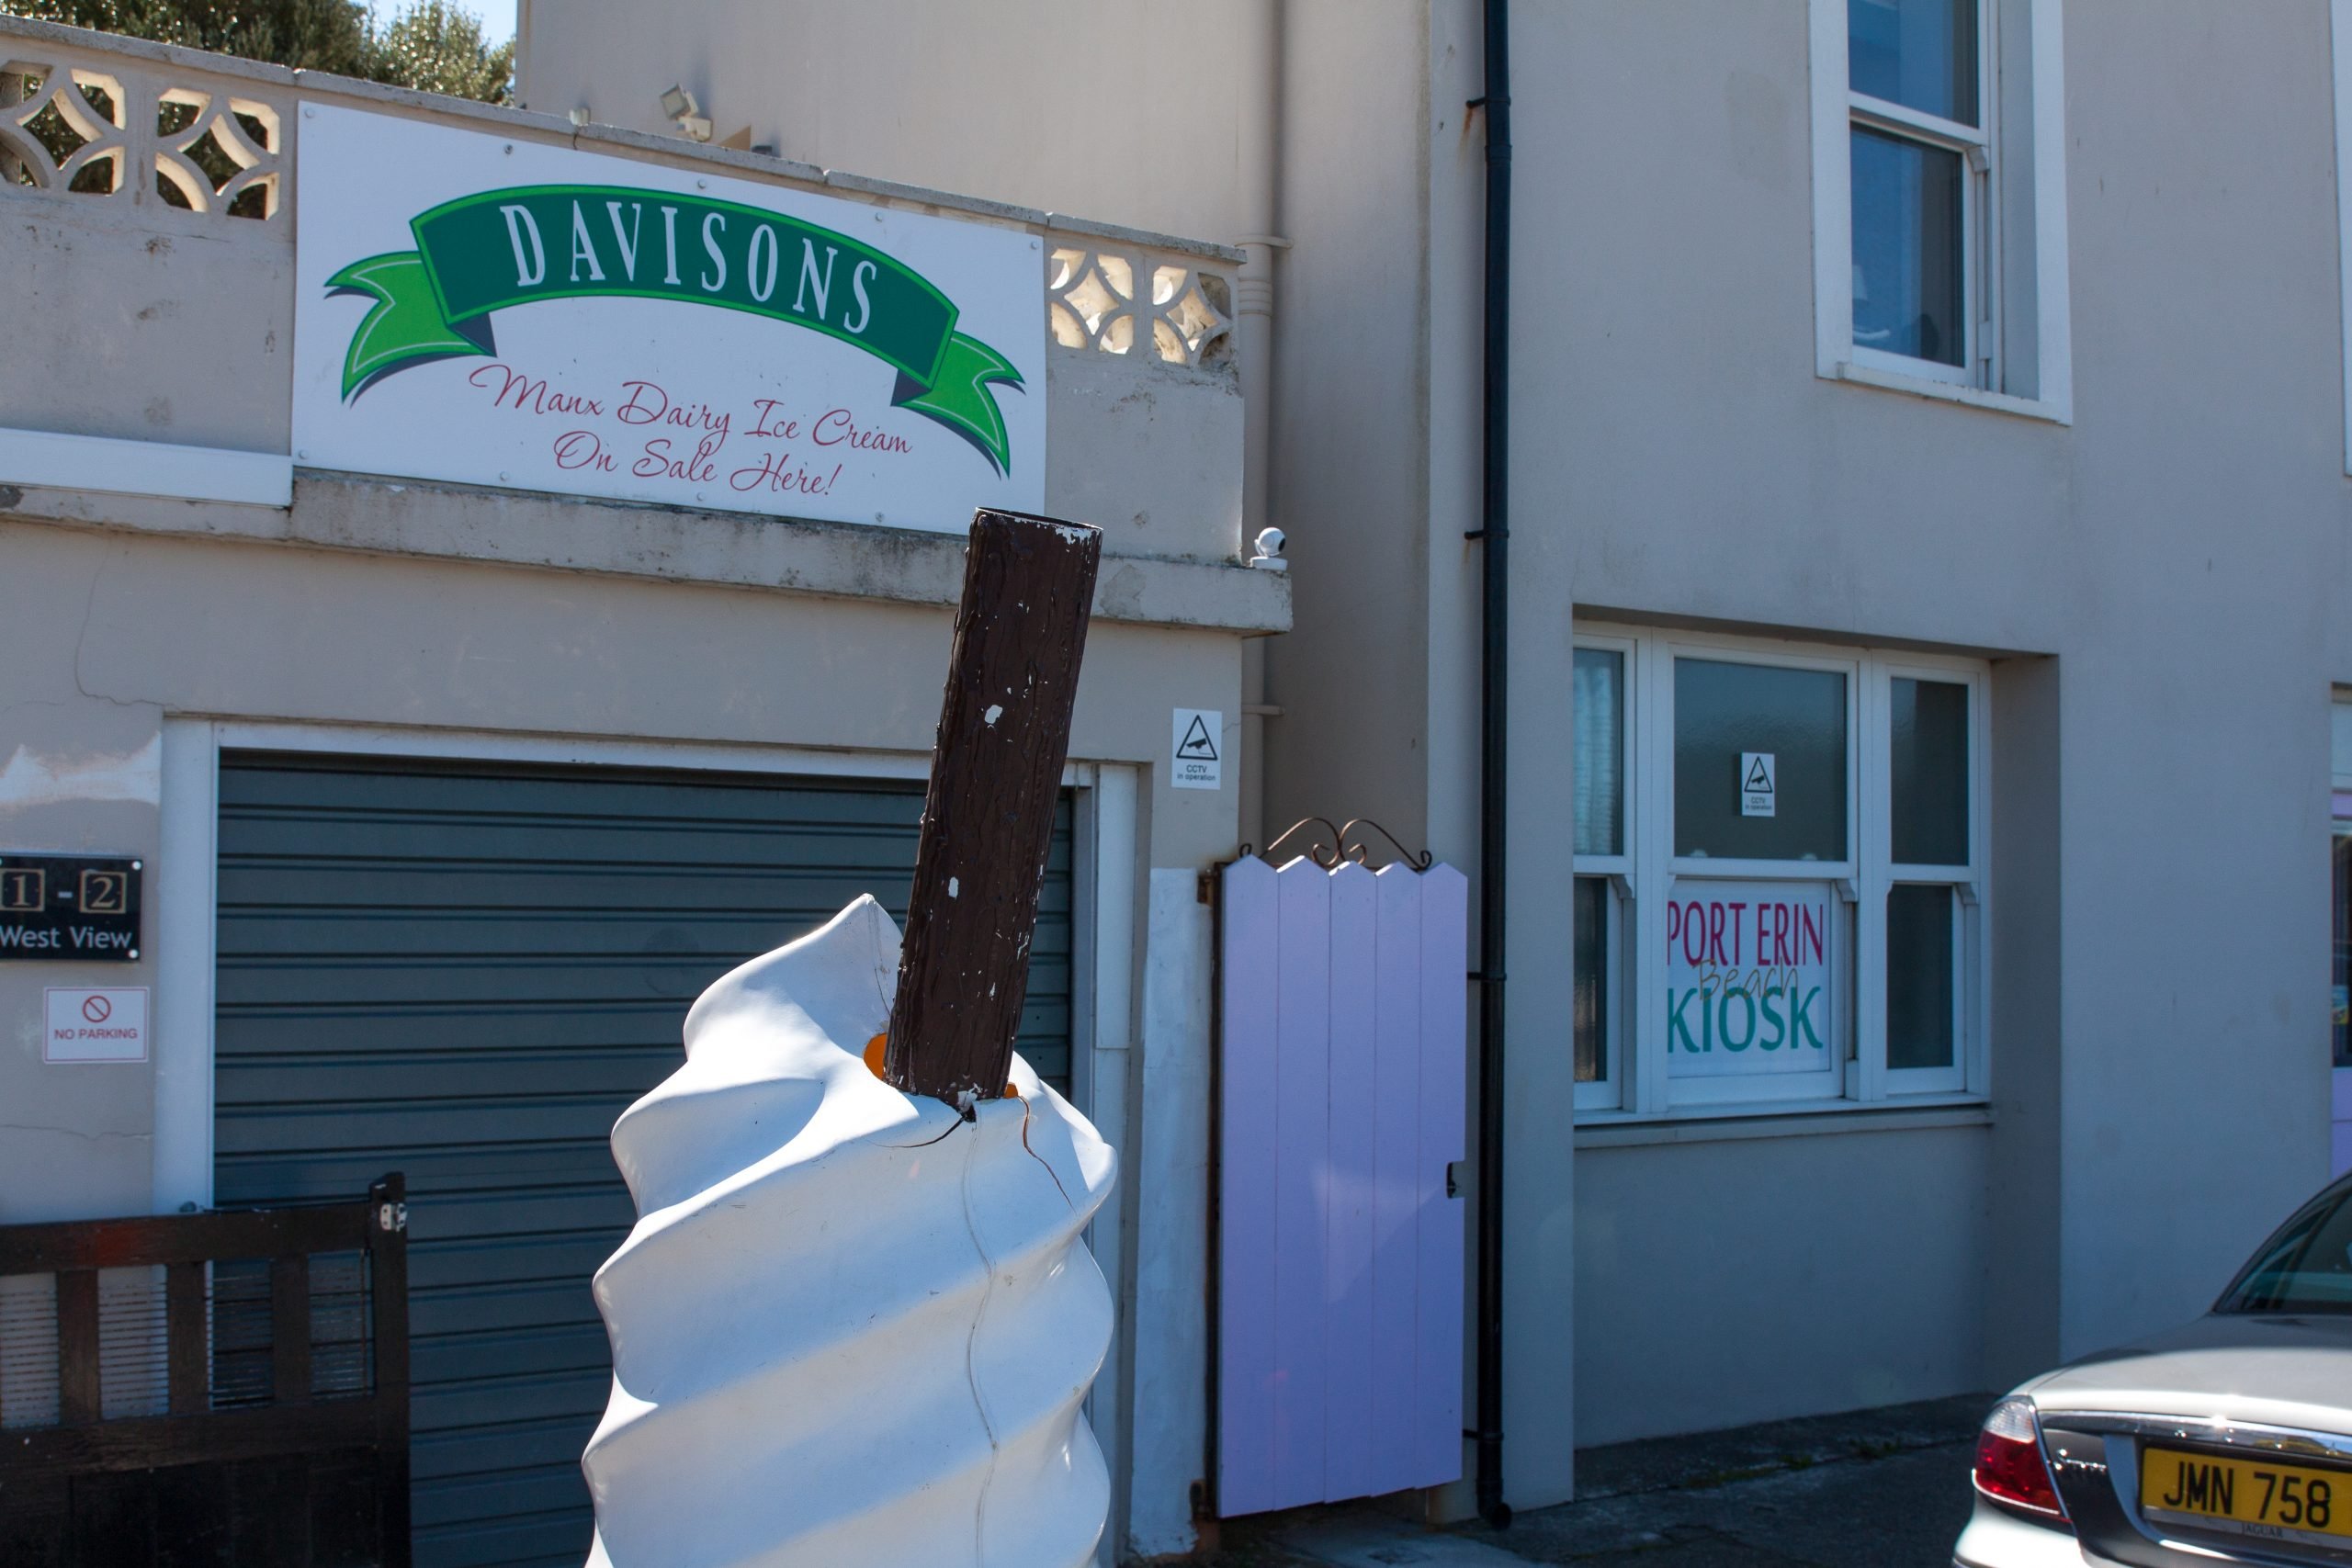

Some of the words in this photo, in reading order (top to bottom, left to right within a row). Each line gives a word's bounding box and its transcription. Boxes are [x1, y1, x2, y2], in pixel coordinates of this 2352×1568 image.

[500, 198, 878, 334] DAVISONS
[469, 364, 605, 415] Manx
[617, 381, 729, 457] Dairy
[743, 400, 800, 439] Ice
[812, 409, 912, 454] Cream
[553, 430, 618, 472] On
[632, 439, 718, 482] Sale
[729, 453, 843, 496] Here!
[1186, 764, 1207, 773] CCTV
[0, 926, 62, 949] West
[70, 926, 132, 949] View
[1668, 901, 1747, 966] PORT
[1757, 902, 1824, 966] ERIN
[1691, 956, 1799, 1000] Beach
[53, 1028, 75, 1040] NO
[78, 1027, 138, 1040] PARKING
[1668, 986, 1824, 1054] KIOSK
[2164, 1461, 2234, 1515] JMN
[2254, 1472, 2332, 1529] 758
[2242, 1522, 2284, 1539] JAGUAR
